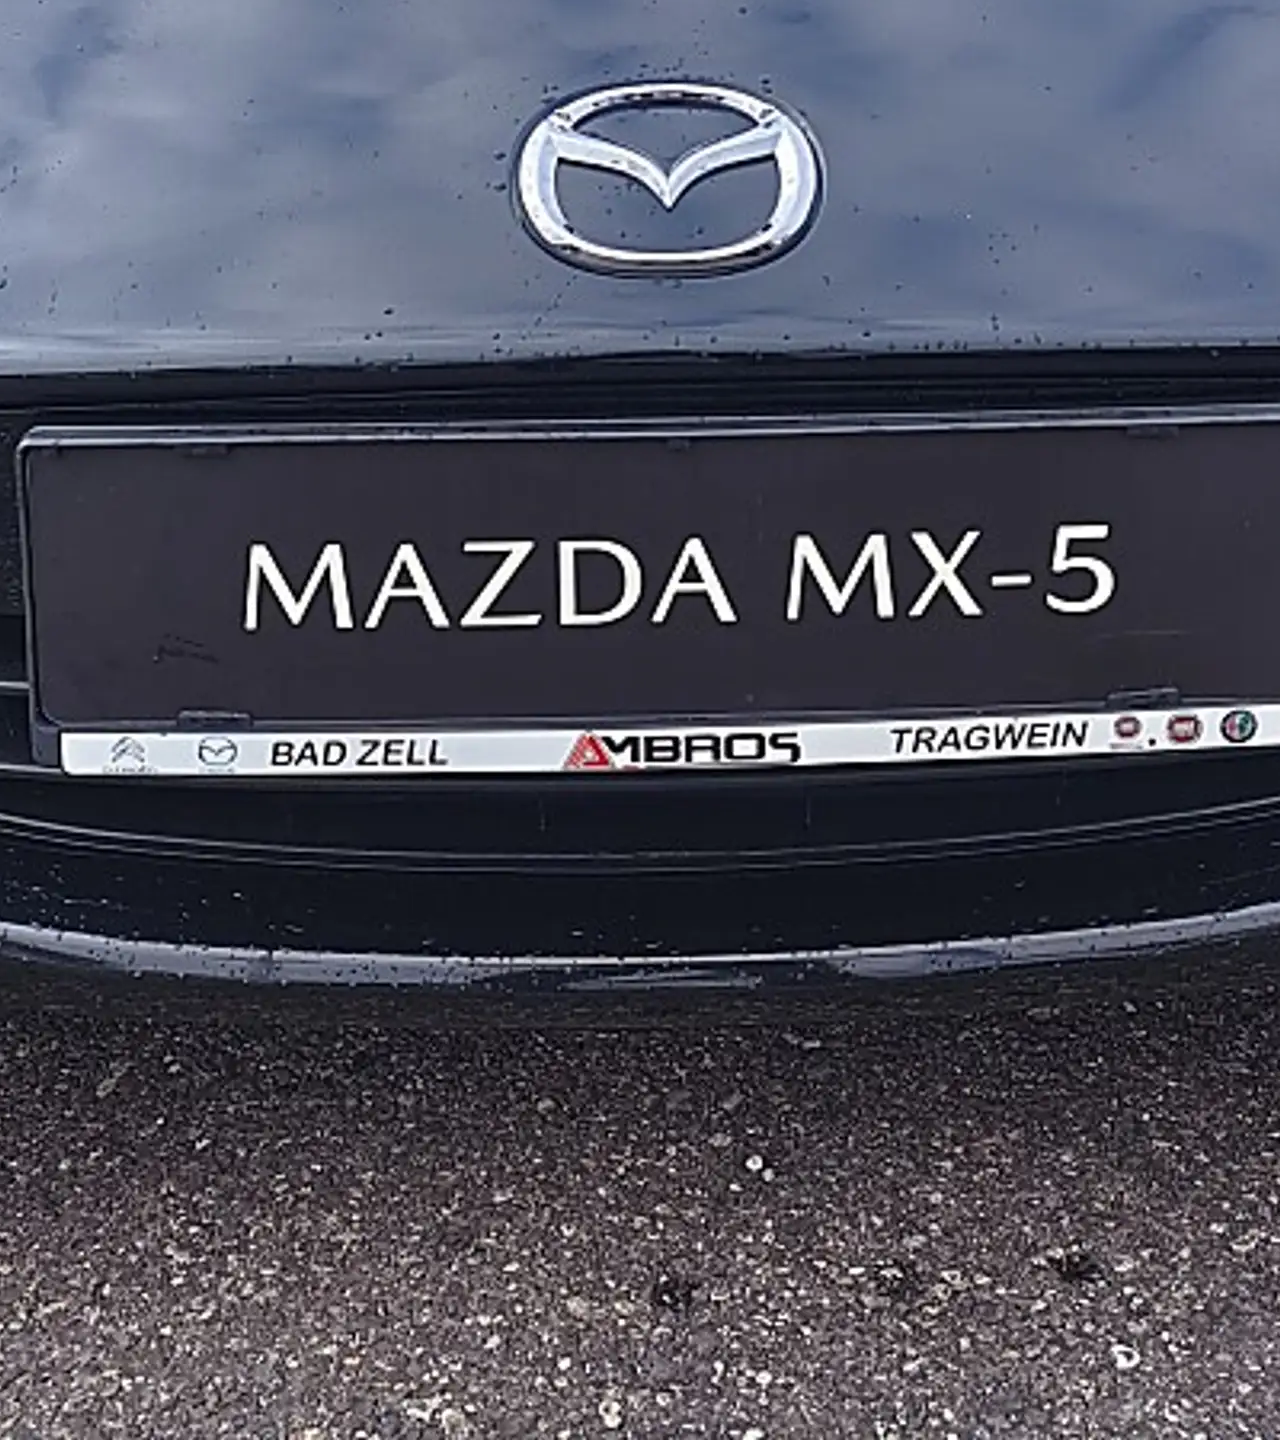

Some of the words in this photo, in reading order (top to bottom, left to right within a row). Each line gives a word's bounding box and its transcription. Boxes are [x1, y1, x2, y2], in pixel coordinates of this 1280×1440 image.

[244, 537, 738, 632] MAZDA
[786, 524, 1117, 621] MX-5
[270, 740, 347, 766] BAD
[356, 739, 449, 766] ZELL
[564, 730, 802, 771] AMBROS
[890, 721, 1089, 754] TRAGWEIN
